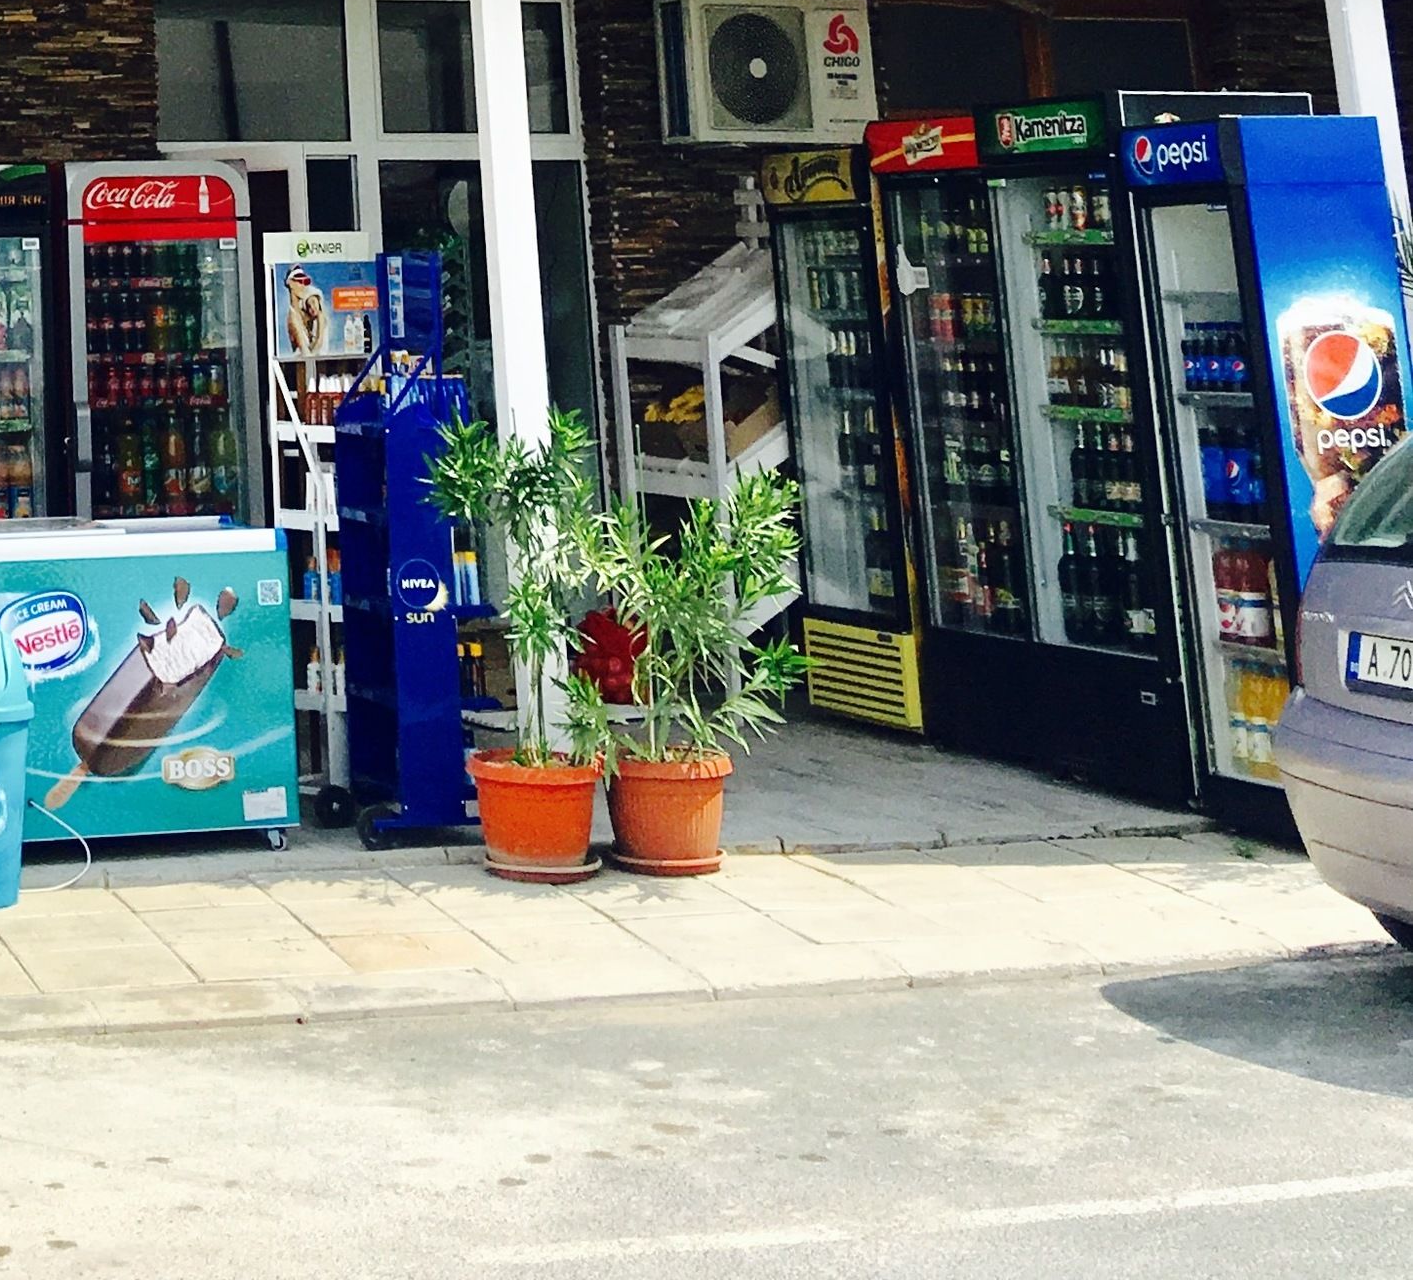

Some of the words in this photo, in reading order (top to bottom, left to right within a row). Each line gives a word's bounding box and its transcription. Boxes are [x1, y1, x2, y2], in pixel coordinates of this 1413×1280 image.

[823, 57, 860, 67] CHIGO
[1014, 111, 1085, 141] Kamenitza
[1157, 135, 1209, 172] pepsi
[86, 180, 180, 209] Coca-Cola
[296, 240, 343, 257] GARNIER
[1316, 422, 1387, 455] pepsi
[401, 579, 436, 589] NIVEA
[30, 599, 67, 615] CREAM
[169, 757, 231, 779] BOSS
